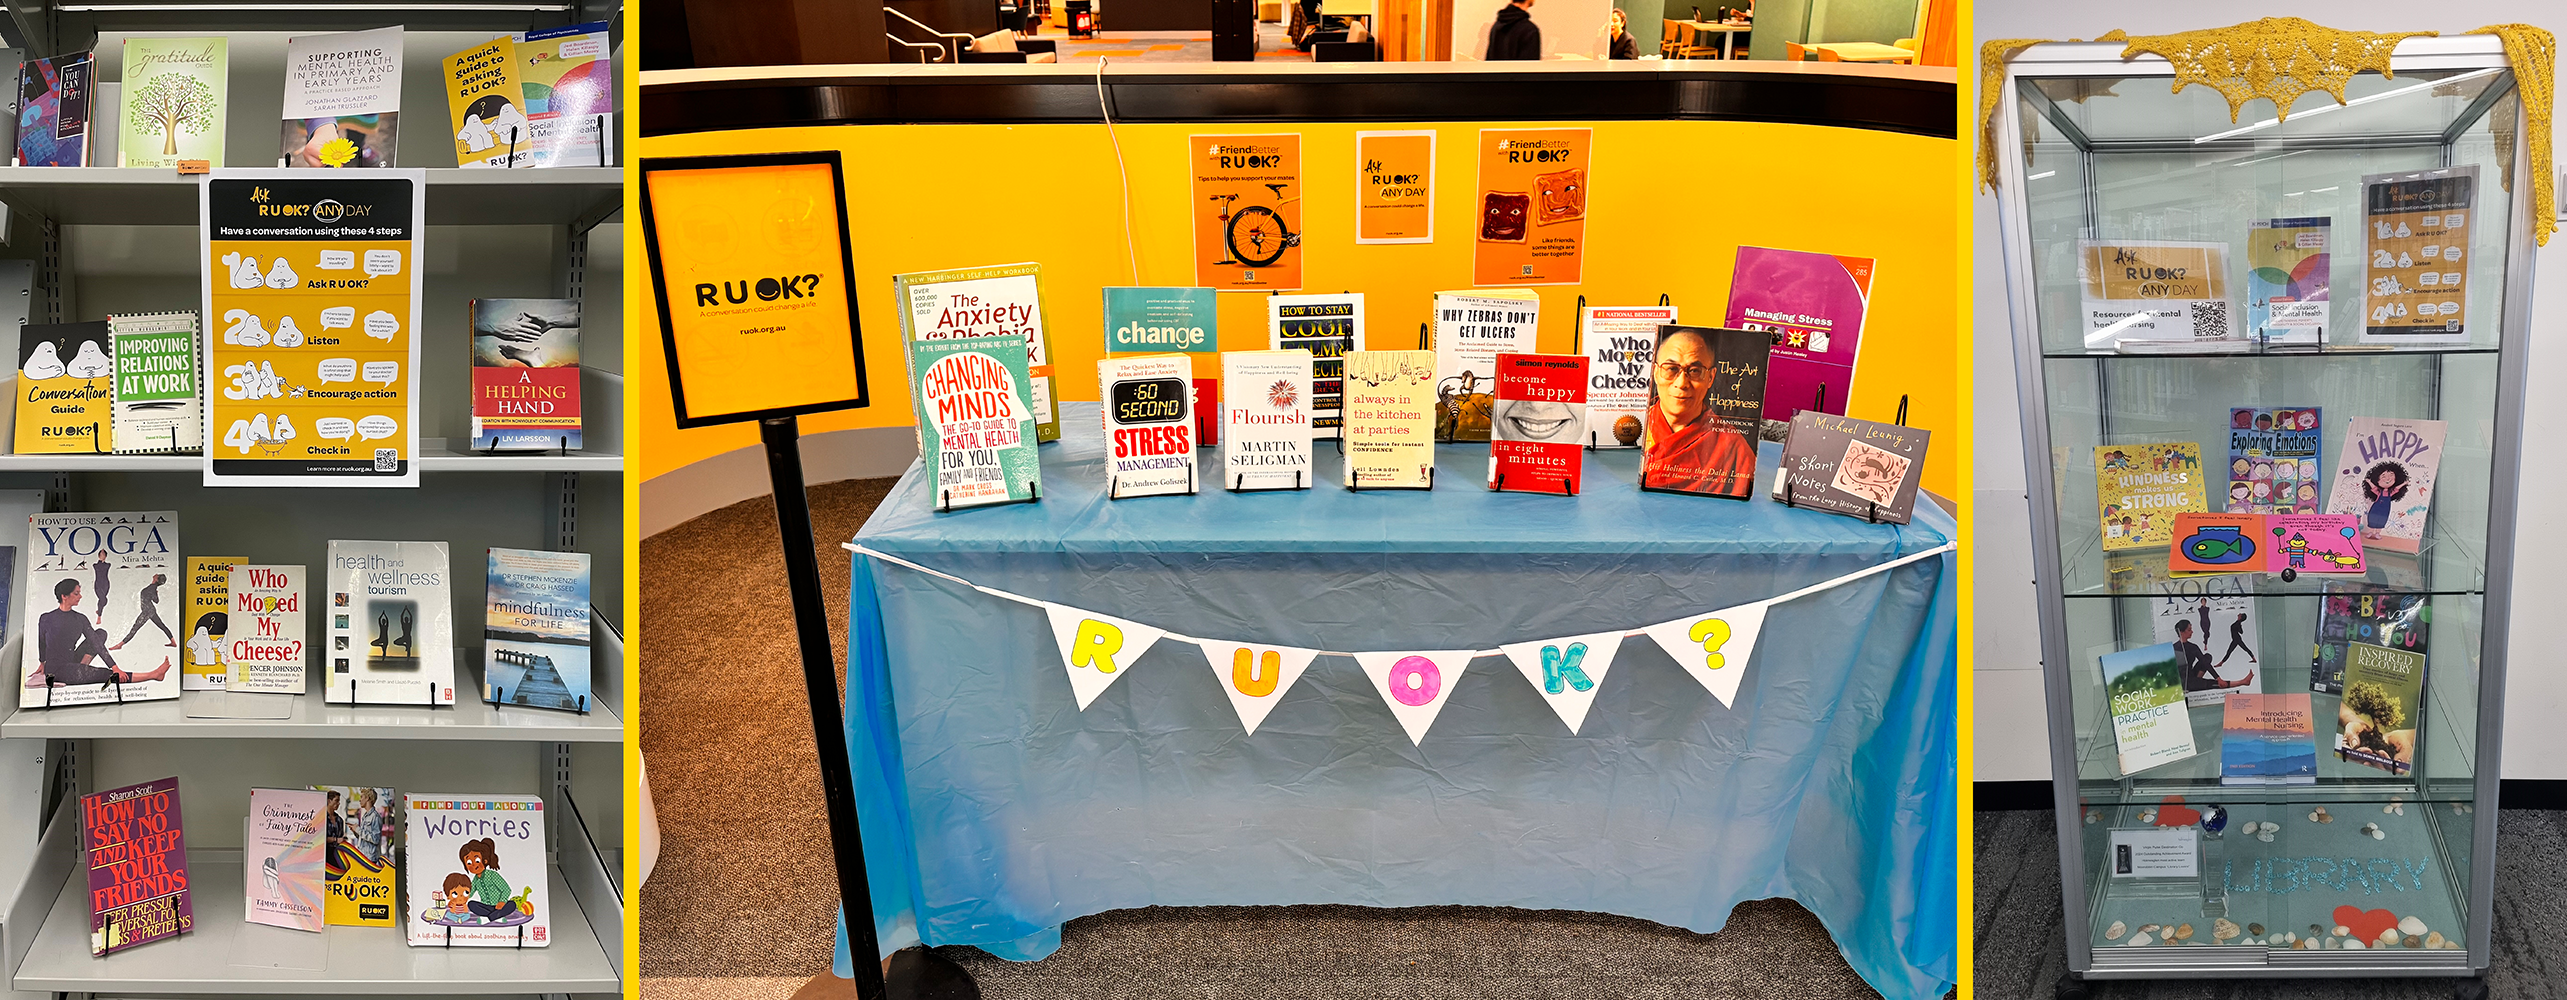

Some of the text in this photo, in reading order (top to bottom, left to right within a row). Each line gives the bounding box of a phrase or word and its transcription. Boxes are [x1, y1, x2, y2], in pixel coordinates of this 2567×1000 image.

[128, 42, 216, 78] gratitude
[298, 56, 392, 71] MENTAL HEALTH
[308, 48, 382, 62] SUPPORTING
[311, 67, 364, 78] PRIMARY
[368, 65, 394, 75] AND
[304, 75, 382, 89] EARLY YEARS
[314, 102, 367, 112] SARAH TRUSSLER
[1209, 144, 1280, 155] #FriendBetter
[1498, 139, 1570, 149] #FriendBetter
[250, 186, 270, 203] Ask
[1381, 188, 1426, 197] ANY DAY
[259, 206, 268, 216] R
[271, 205, 280, 216] U
[315, 205, 343, 216] ANY
[346, 205, 372, 216] DAY
[221, 227, 243, 235] Have
[252, 227, 313, 235] conversation
[315, 228, 339, 237] using
[341, 227, 366, 235] these
[368, 227, 374, 235] 4
[376, 227, 402, 236] steps
[696, 284, 719, 307] R
[724, 280, 748, 304] U
[951, 294, 979, 308] The
[937, 303, 1032, 329] Anxiety
[1443, 309, 1535, 324] WHY ZEBRAS DON'T
[1744, 308, 1833, 326] Managing Stress
[740, 325, 786, 335] ruok.org.au
[1117, 321, 1204, 349] change
[1460, 326, 1515, 338] GET ULCERS
[120, 337, 188, 355] IMPROVING
[308, 336, 339, 345] Listen
[121, 355, 189, 373] RELATIONS
[1718, 361, 1758, 376] The Art
[122, 374, 190, 394] AT WORK
[926, 355, 1008, 399] CHANGING
[1503, 374, 1546, 383] become
[28, 380, 107, 402] Conversation
[308, 390, 397, 400] Encourage action
[485, 386, 566, 398] HELPING
[1527, 384, 1576, 401] happy
[498, 401, 554, 414] HAND
[938, 392, 1011, 423] MINDS
[1354, 394, 1410, 406] always in
[1709, 393, 1759, 410] Happiness
[51, 405, 85, 413] Guide
[1121, 400, 1179, 418] SECOND
[1232, 409, 1306, 424] Flourish
[1354, 410, 1421, 419] the kitchen
[1354, 426, 1410, 436] at parties
[1814, 417, 1904, 447] Michael Leunig
[943, 430, 1019, 450] MENTAL HEALTH
[1114, 426, 1189, 458] STRESS
[1242, 441, 1296, 452] MARTIN
[1516, 443, 1544, 454] eight
[2231, 432, 2317, 456] Exploring Emotions
[2358, 430, 2429, 464] HAPPY
[307, 446, 350, 454] Check in
[1117, 457, 1190, 472] MANAGEMENT
[1232, 455, 1306, 465] SELIGMAN
[1509, 453, 1566, 466] minutes
[1799, 455, 1834, 472] Short
[1788, 473, 1826, 492] Notes
[2119, 472, 2188, 488] KINDNESS
[2121, 493, 2189, 509] STRONG
[38, 526, 169, 556] YOGA
[336, 554, 404, 570] health and
[248, 568, 287, 589] Who
[368, 569, 440, 586] wellness
[368, 585, 407, 596] tourism
[2159, 576, 2247, 605] YOGA
[494, 601, 585, 619] mindfulness
[257, 617, 281, 641] My
[515, 617, 564, 629] FOR LIFE
[233, 641, 302, 661] Cheese?
[1070, 617, 1124, 674] R
[1232, 647, 1281, 697] U
[2359, 647, 2412, 665] INSPIRED
[2358, 657, 2412, 674] RECOVERY
[2114, 689, 2157, 705] SOCIAL
[2116, 699, 2153, 714] WORK
[2118, 705, 2169, 726] PRACTICE
[2122, 732, 2149, 743] health
[109, 785, 153, 802] Sharon Scott
[140, 793, 169, 816] TO
[263, 803, 315, 821] Grimmest
[94, 813, 168, 848] SAY NO
[266, 820, 317, 836] Fairy Tales
[424, 815, 530, 839] Worries
[92, 829, 181, 868] AND KEEP
[109, 854, 168, 885] YOUR
[2224, 856, 2429, 895] LIBRARY
[94, 869, 187, 912] FRIENDS
